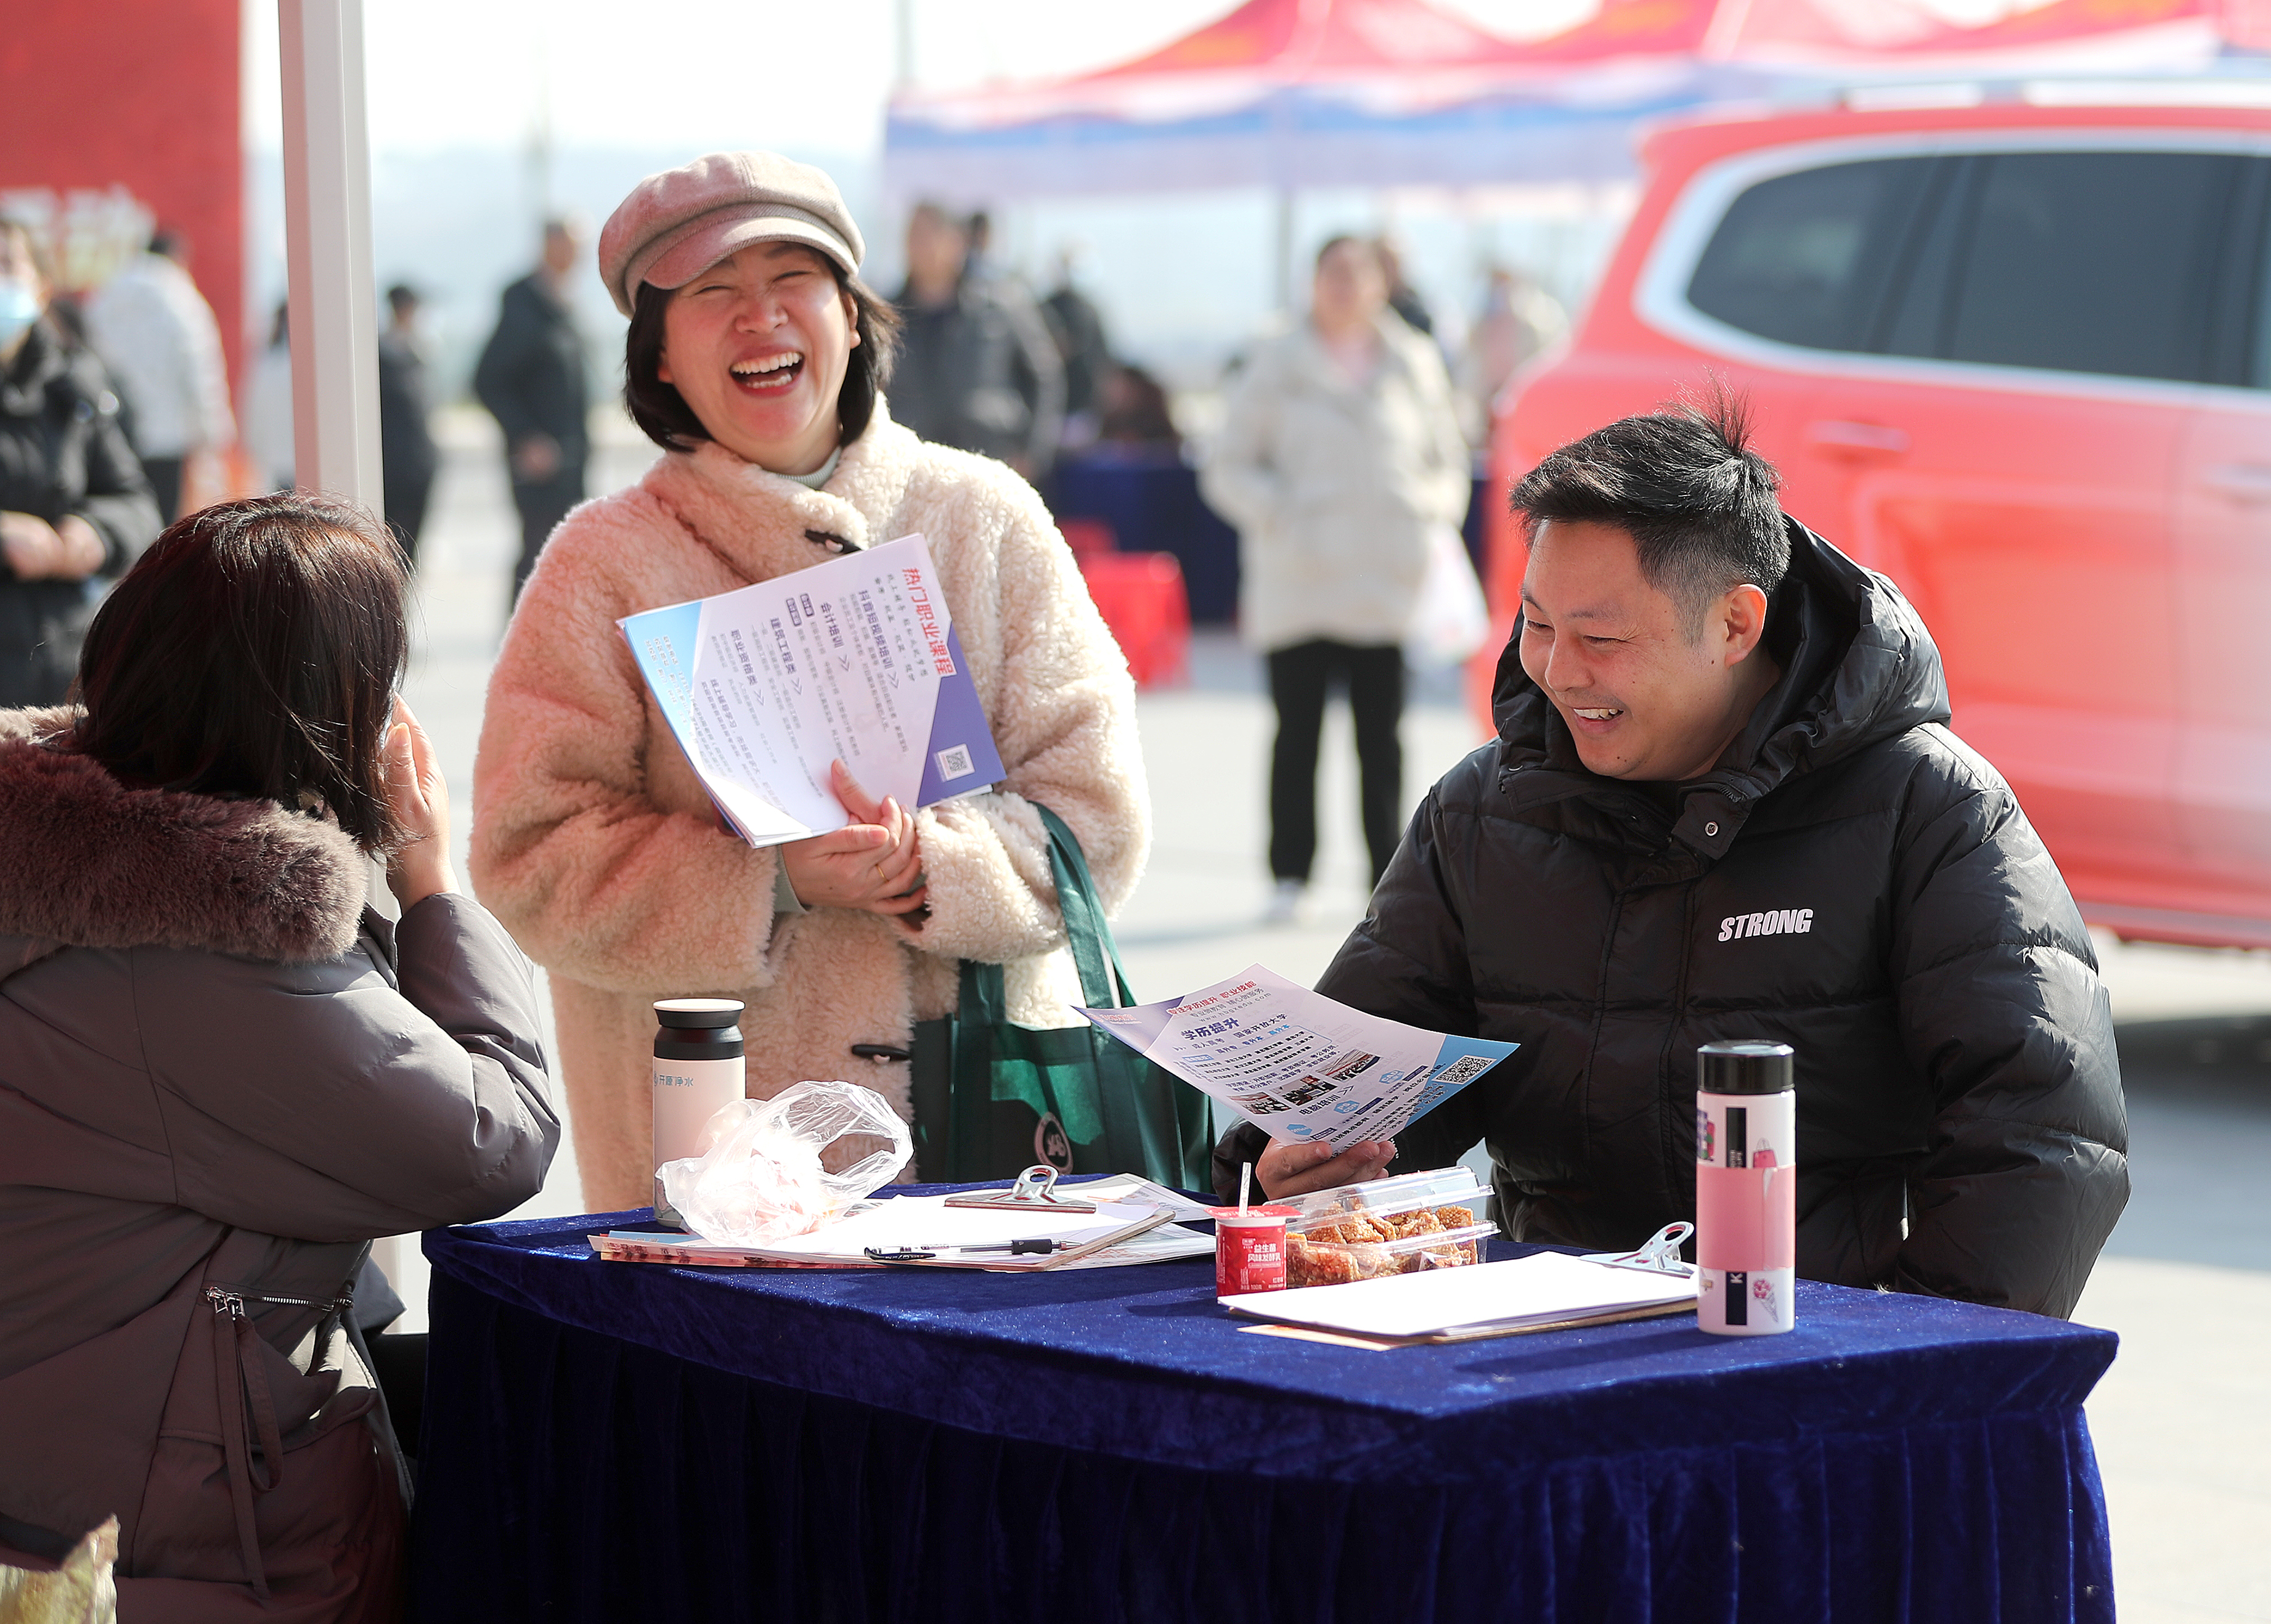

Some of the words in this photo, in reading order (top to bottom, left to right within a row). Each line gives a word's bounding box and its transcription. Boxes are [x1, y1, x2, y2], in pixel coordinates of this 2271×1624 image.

[819, 600, 845, 649] 会计培训
[857, 588, 895, 671] 抖音短视频培训
[901, 566, 955, 675] 热门职业课程
[730, 628, 759, 687] 职业资格类
[769, 616, 797, 675] 建筑工程类
[1718, 908, 1813, 942] STRONG
[1168, 997, 1218, 1014] 专注学历提升
[1220, 980, 1257, 998] 职业技能
[1180, 1017, 1239, 1041] 学历提升
[1215, 1045, 1237, 1055] 高升专
[1242, 1036, 1264, 1046] 专升本
[1268, 1024, 1290, 1035] 高升本
[1233, 1014, 1287, 1038] 国家开放大学
[1382, 1071, 1398, 1082] CAD
[1299, 1095, 1340, 1115] 电脑培训
[1248, 1252, 1281, 1262] 风味发酵乳
[1254, 1244, 1276, 1252] 益生菌
